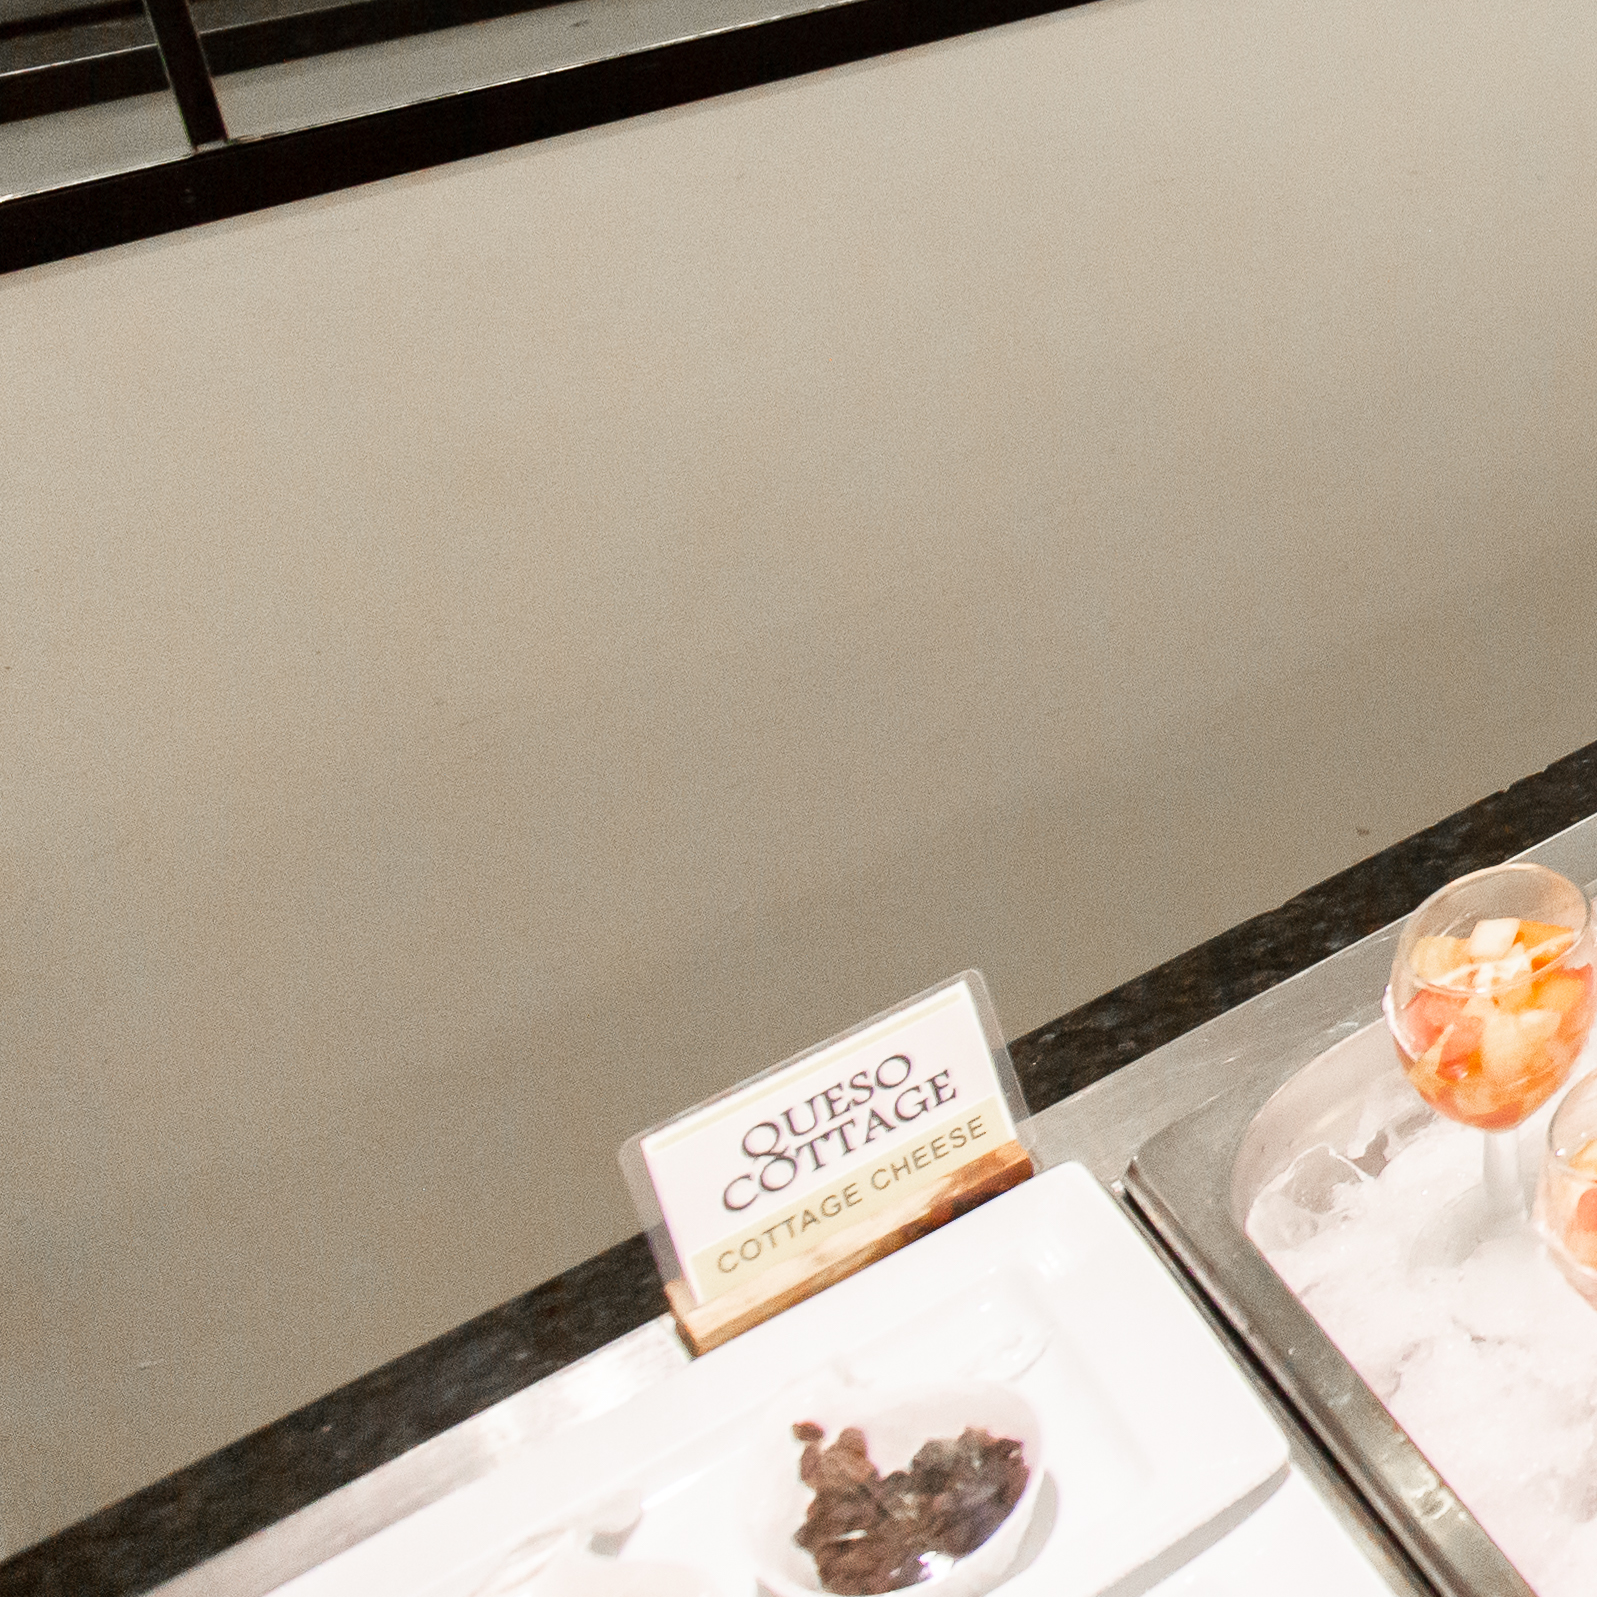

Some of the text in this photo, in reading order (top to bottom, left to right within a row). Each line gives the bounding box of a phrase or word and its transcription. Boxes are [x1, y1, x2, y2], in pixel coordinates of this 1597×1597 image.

[722, 1070, 957, 1212] COTTAGE
[741, 1054, 912, 1162] QUESO
[717, 1115, 987, 1274] COTTAGE CHEESE
